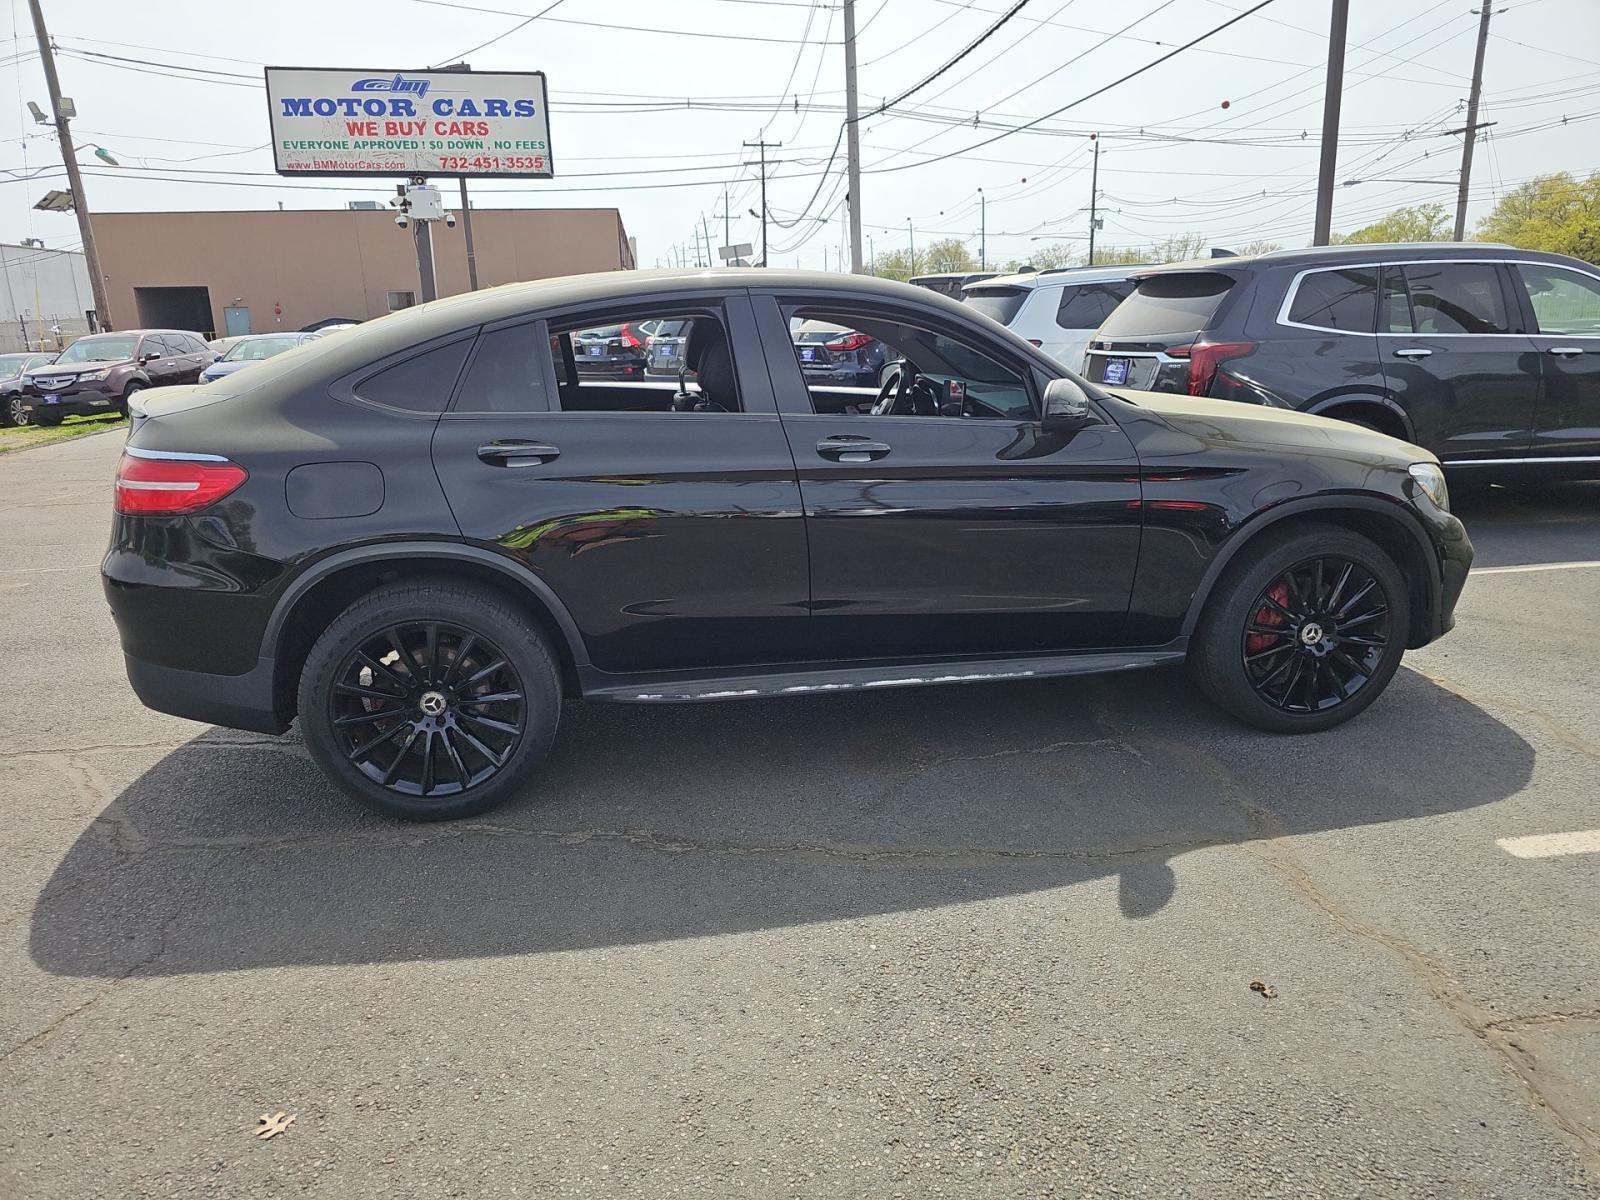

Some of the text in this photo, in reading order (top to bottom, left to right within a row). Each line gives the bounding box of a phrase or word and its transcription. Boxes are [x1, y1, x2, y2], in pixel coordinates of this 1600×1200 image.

[281, 98, 536, 118] MOTOR CARS
[346, 121, 490, 137] WE BUY CARS
[283, 140, 349, 150] EVERYONE
[430, 140, 444, 150] $0
[495, 140, 512, 151] NO
[516, 140, 546, 151] FEES
[286, 157, 545, 170] www.BMMotorCars.com 732-451-3535
